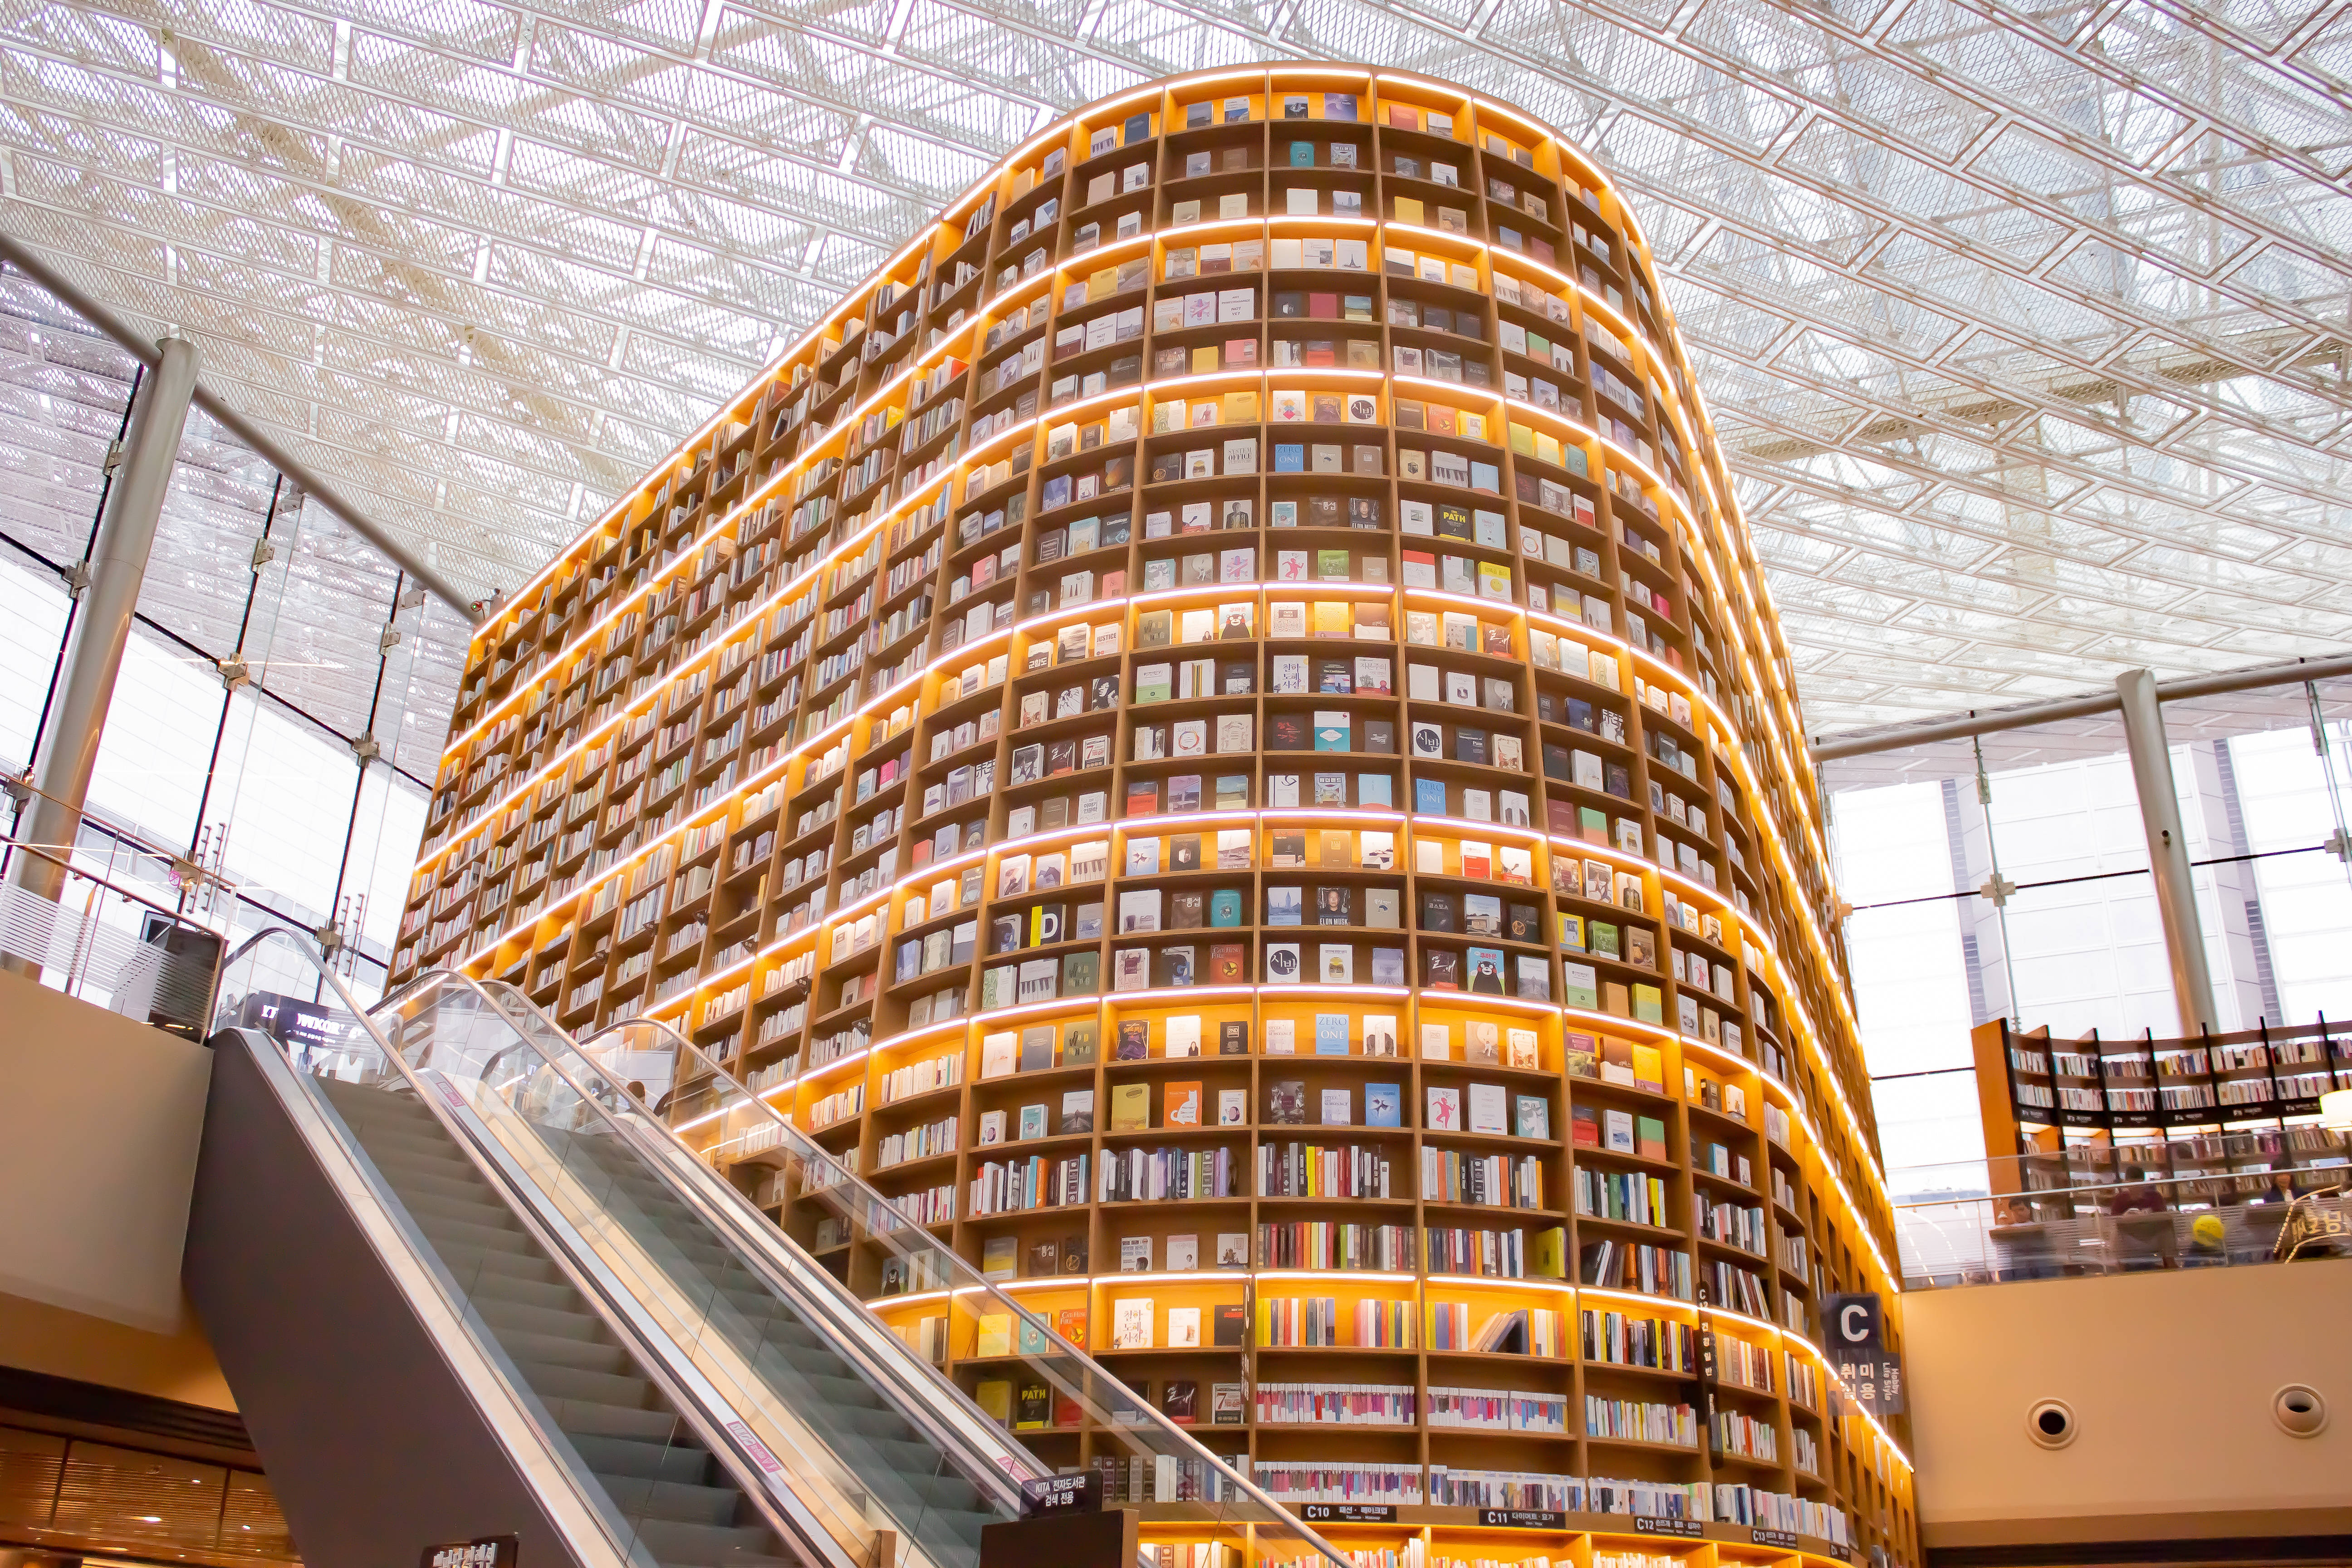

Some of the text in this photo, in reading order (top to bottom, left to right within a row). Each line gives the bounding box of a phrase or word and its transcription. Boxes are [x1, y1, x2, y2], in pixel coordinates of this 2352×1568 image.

[1228, 453, 1252, 461] OFFICE
[1279, 456, 1299, 464] ONE
[1443, 511, 1466, 523] PATH
[1097, 632, 1117, 643] JUSTICE
[1419, 781, 1444, 793] ZERO
[1421, 793, 1441, 804] ONE
[1040, 913, 1058, 939] D
[1271, 952, 1297, 974] 시밤
[1318, 1016, 1347, 1026] ZERO
[1321, 1030, 1344, 1040] ONE
[1700, 1289, 1706, 1300] C
[1841, 1304, 1869, 1342] C
[1841, 1363, 1874, 1380] 취미
[1022, 1389, 1046, 1401] PATH
[1035, 1475, 1086, 1494] KITA 전자도서관
[1045, 1491, 1074, 1507] 검색 전용
[1307, 1505, 1330, 1518] C10
[1488, 1511, 1507, 1524] C11
[1637, 1518, 1654, 1531] C12
